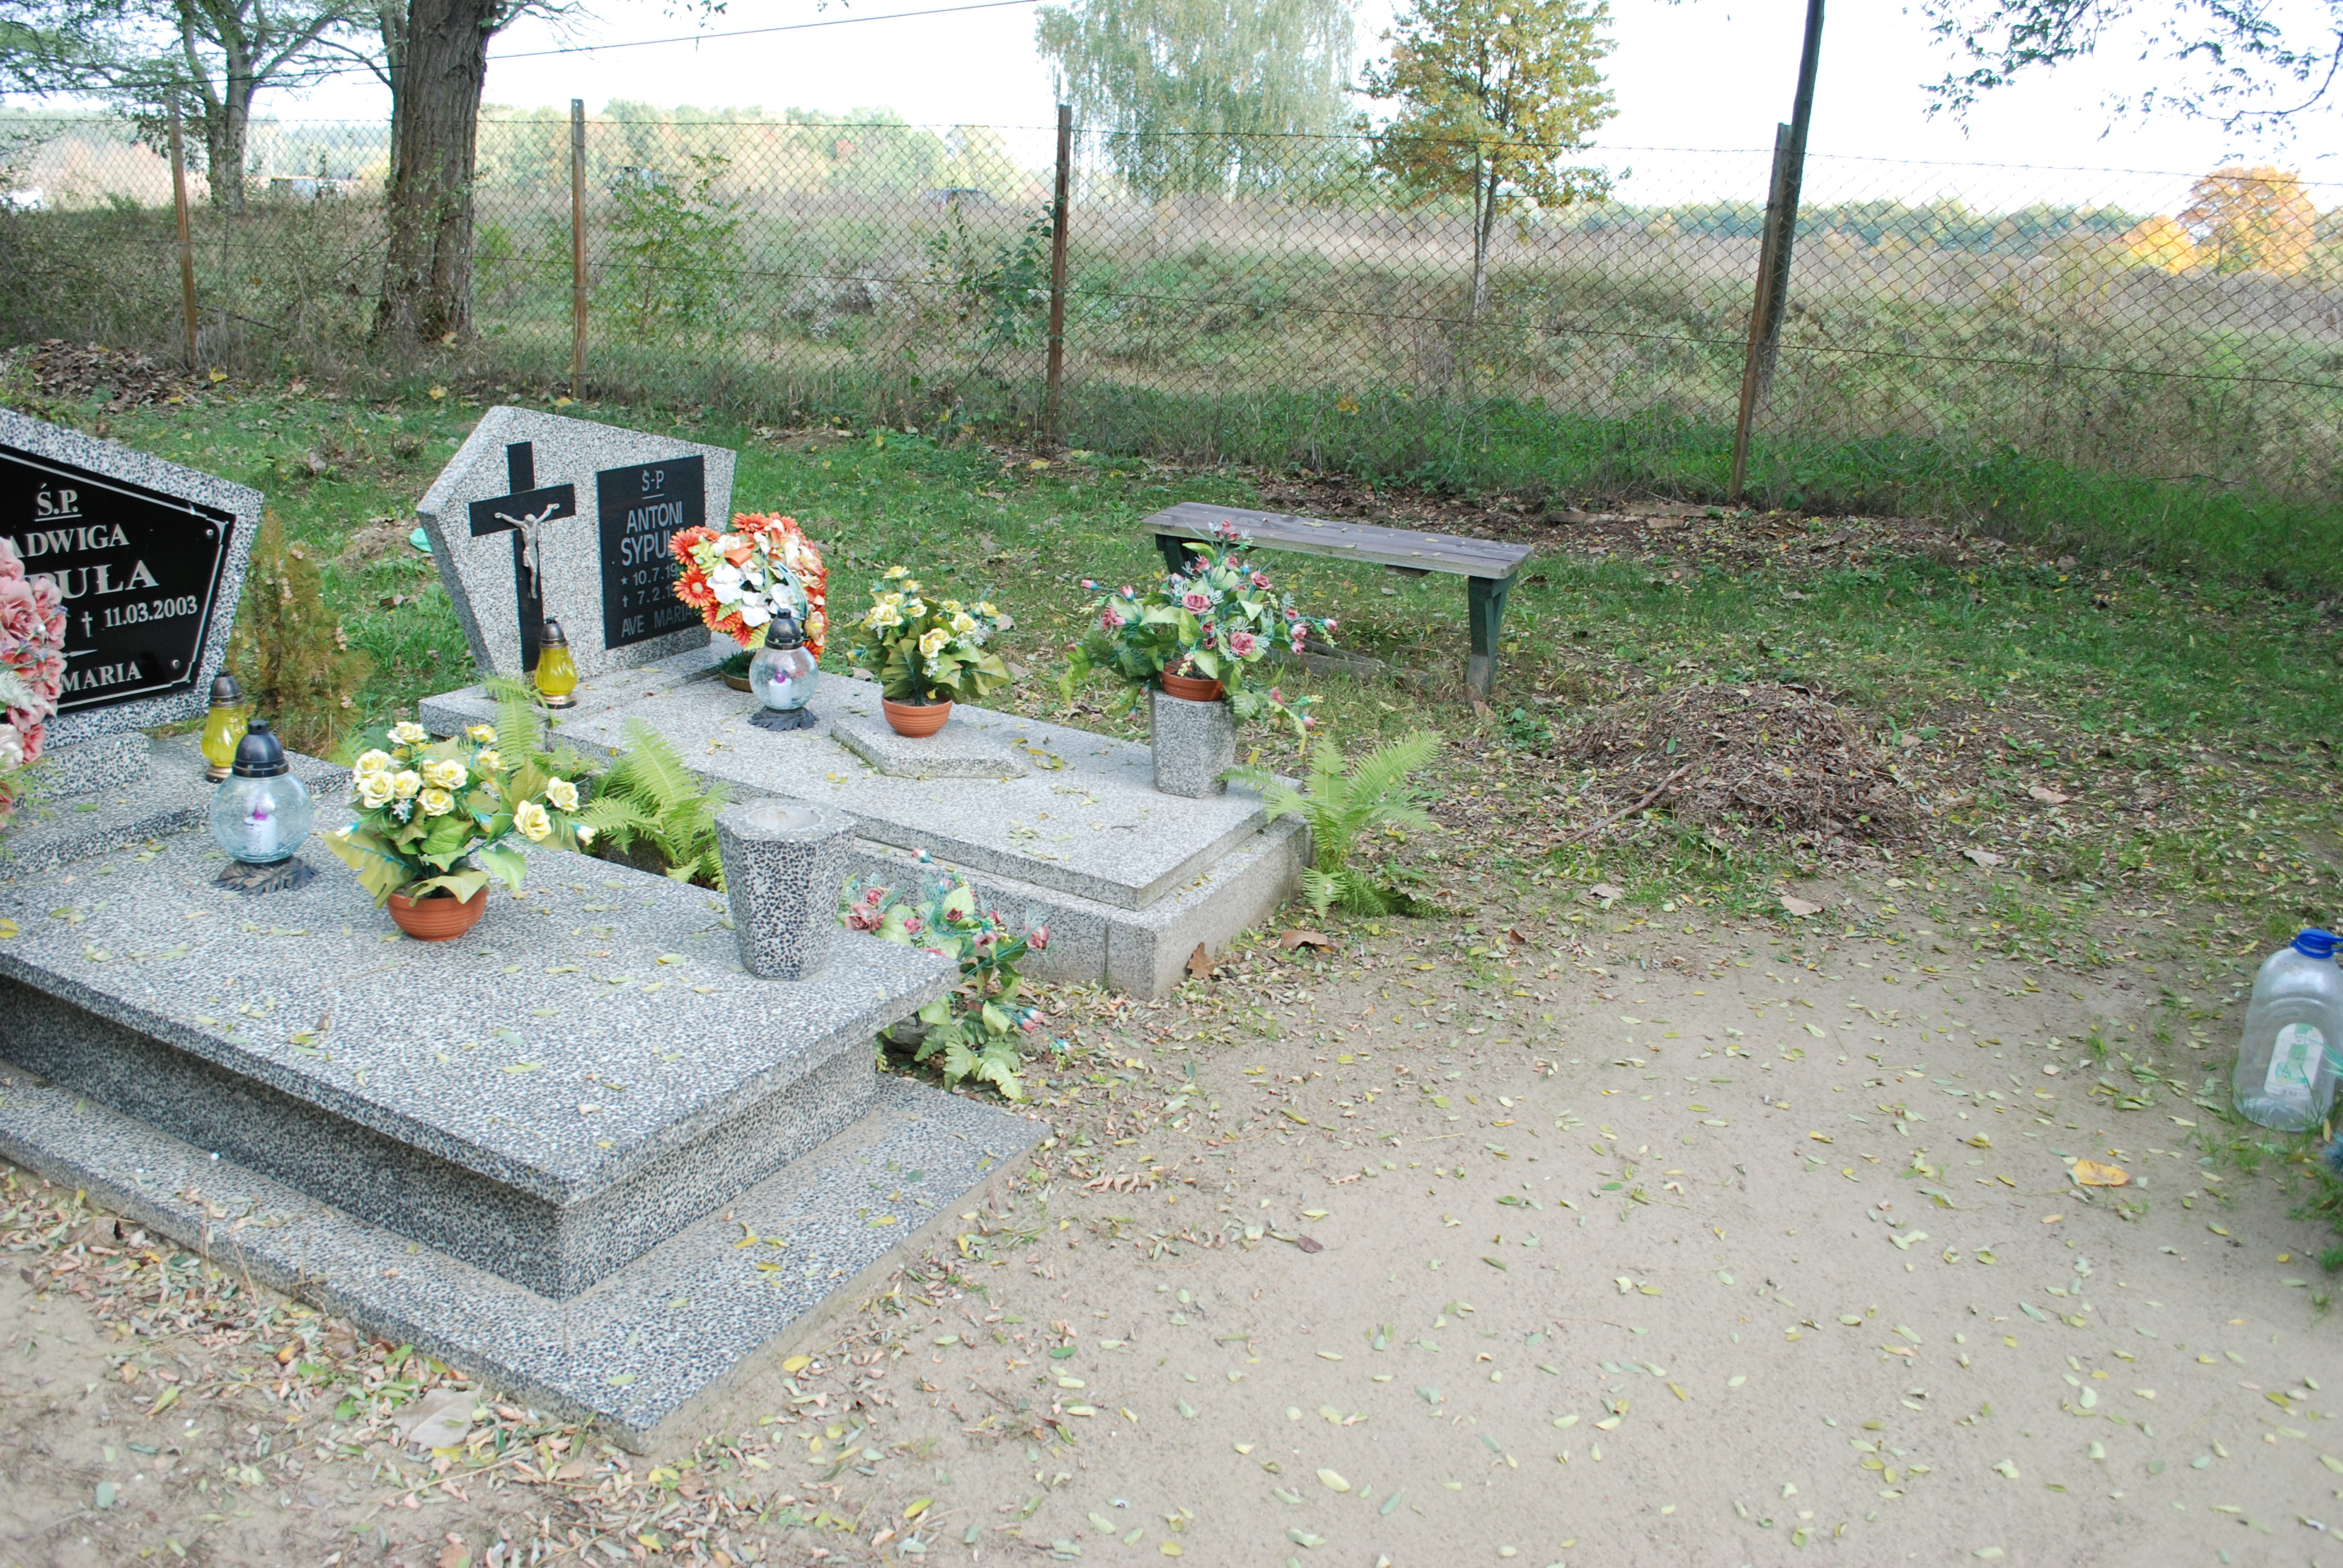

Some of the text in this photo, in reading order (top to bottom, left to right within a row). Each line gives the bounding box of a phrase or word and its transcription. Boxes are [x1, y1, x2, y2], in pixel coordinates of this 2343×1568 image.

[36, 483, 79, 517] Ś.P.
[626, 501, 683, 534] ANTONI
[621, 527, 684, 566] SYPU
[104, 595, 198, 629] 11.03.2003
[621, 604, 693, 638] AVE MARIA
[60, 661, 143, 693] MARIA
